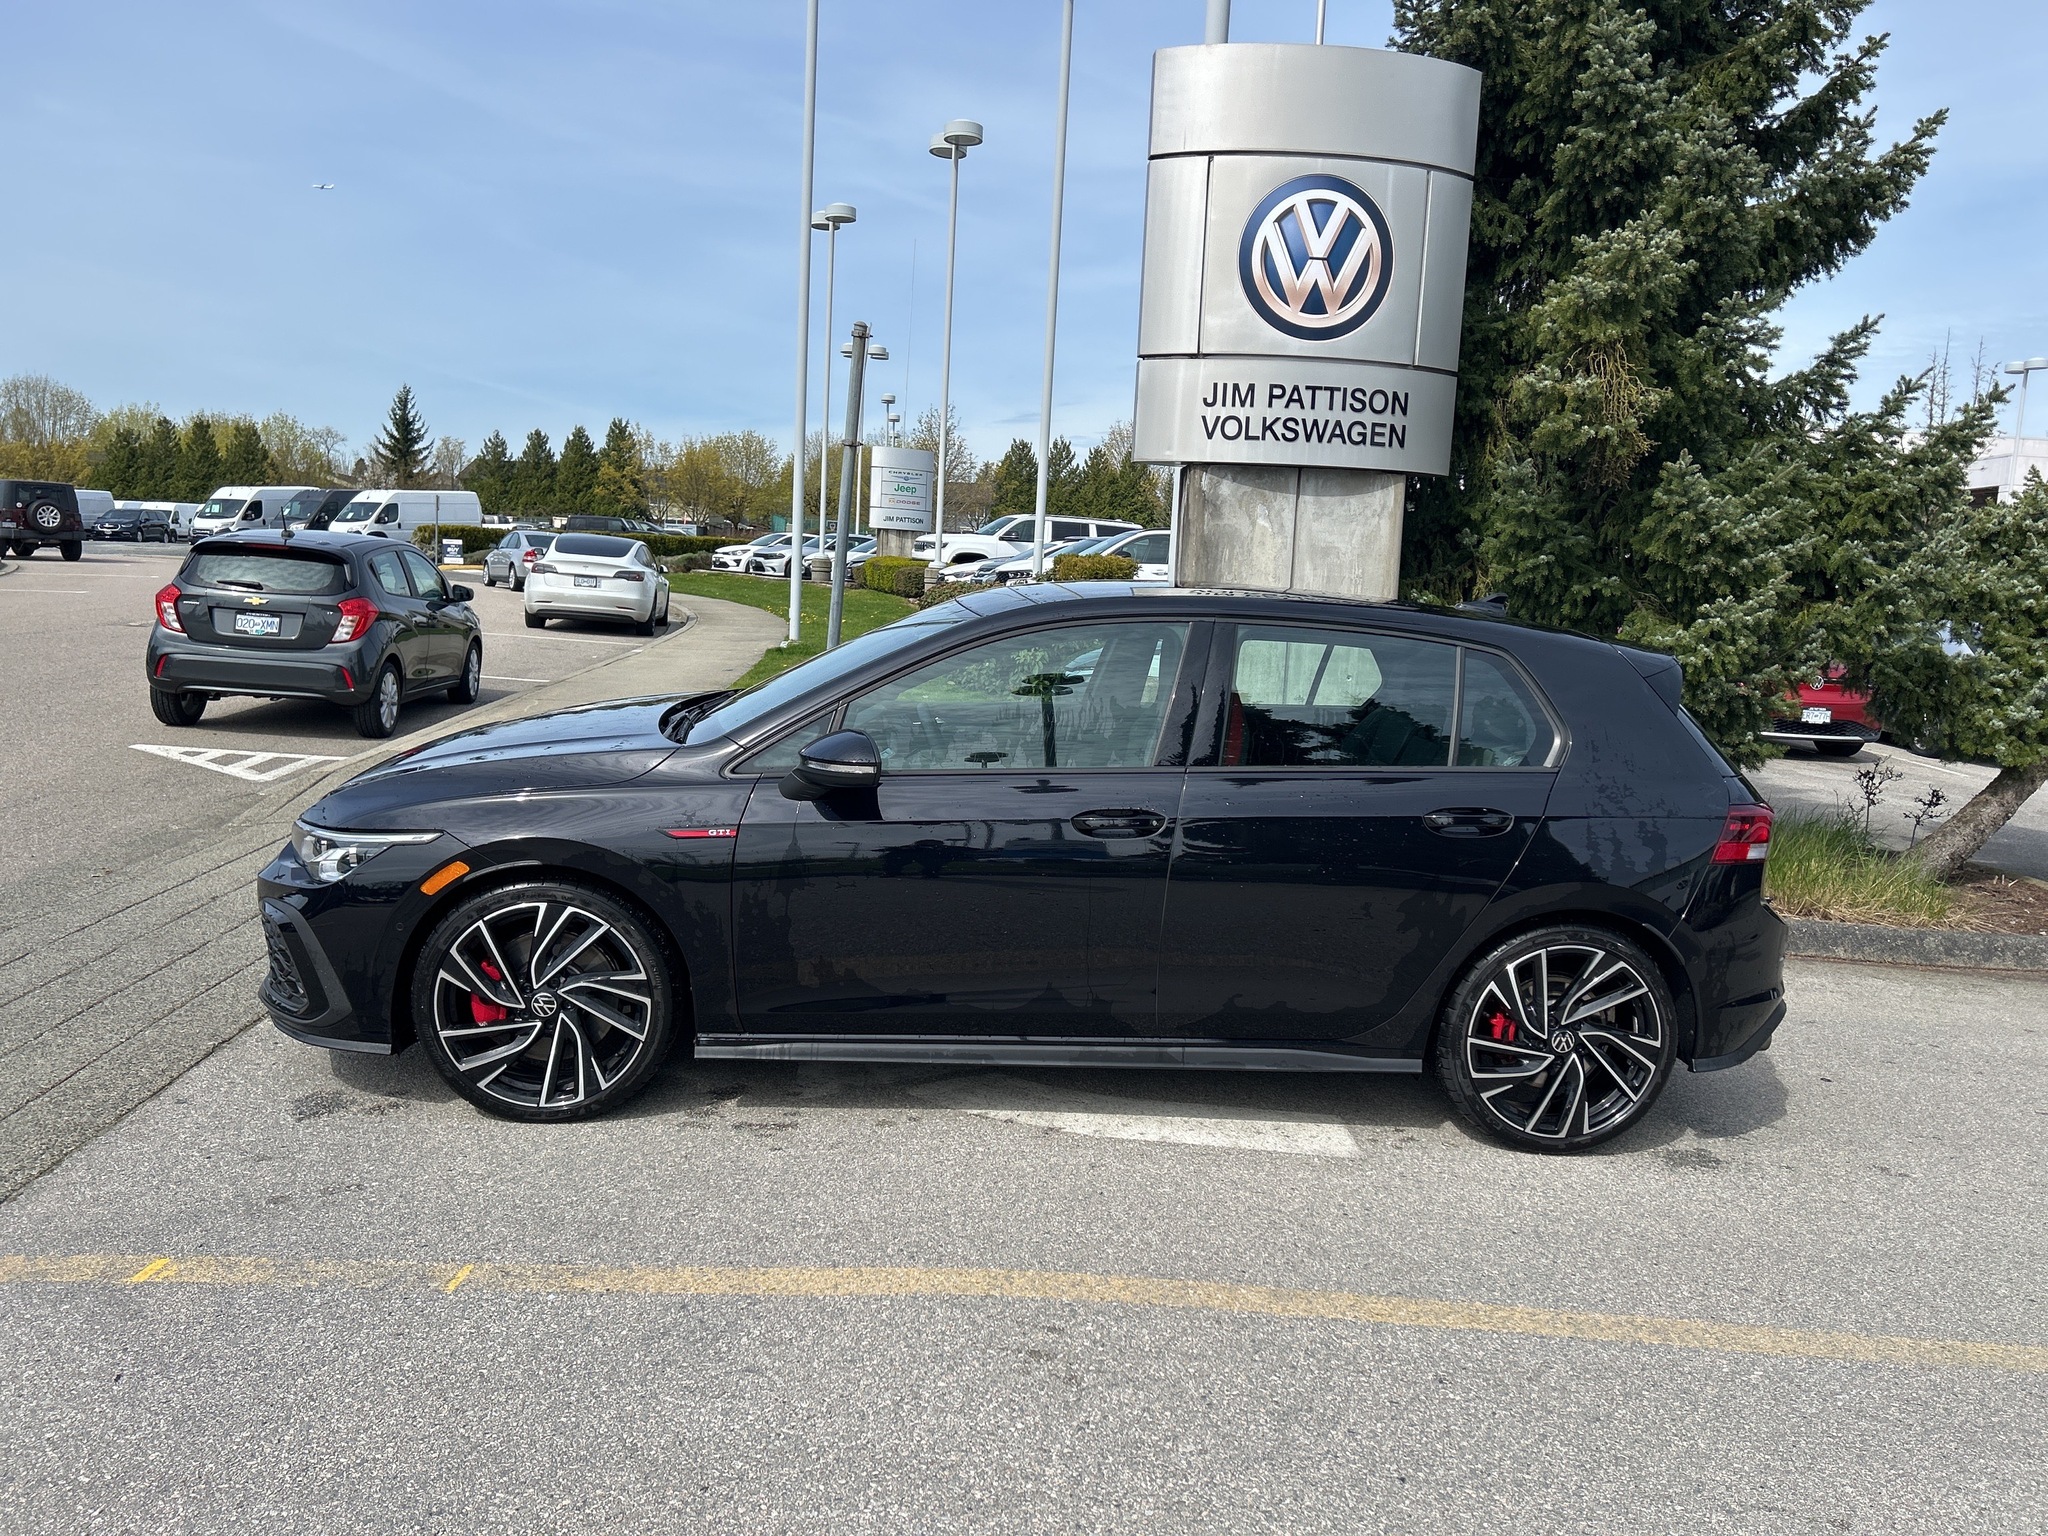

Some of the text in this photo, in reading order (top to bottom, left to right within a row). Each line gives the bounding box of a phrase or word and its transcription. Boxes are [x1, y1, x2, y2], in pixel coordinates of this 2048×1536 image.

[1203, 382, 1409, 416] JIM PATTISON
[1201, 415, 1406, 448] VOLKSWAGEN
[894, 483, 917, 495] Jeep
[895, 516, 924, 525] PATTISON
